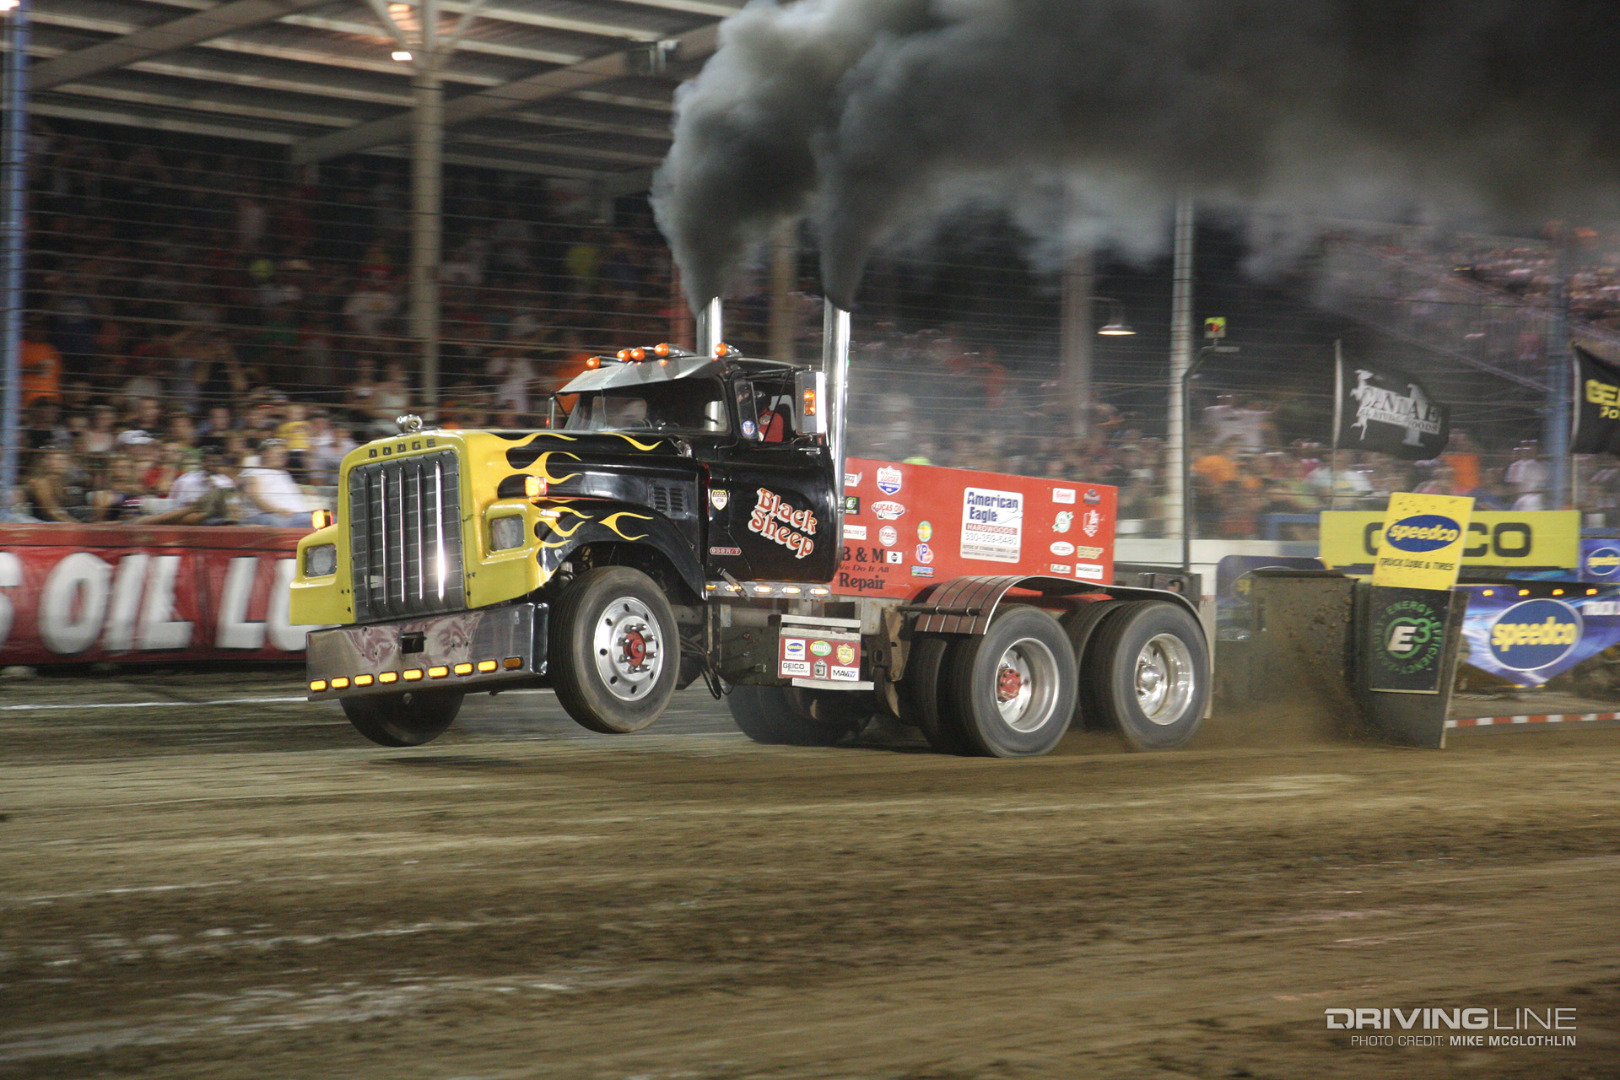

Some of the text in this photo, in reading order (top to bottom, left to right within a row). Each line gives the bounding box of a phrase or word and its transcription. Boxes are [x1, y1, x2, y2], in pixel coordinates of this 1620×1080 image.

[369, 438, 436, 458] DODGE
[874, 502, 893, 512] LUCAS
[967, 491, 1018, 509] American
[757, 488, 817, 535] Black
[969, 506, 998, 523] Eagle
[748, 509, 814, 559] Sheep
[1389, 523, 1459, 543] speedco
[841, 546, 884, 563] B & M
[1380, 557, 1402, 568] TRUCK
[1404, 559, 1423, 569] LUBE
[1434, 561, 1455, 571] TIRES
[839, 572, 886, 592] Repair
[38, 551, 195, 655] OIL
[1491, 616, 1578, 652] speedco
[783, 662, 805, 670] GEICO
